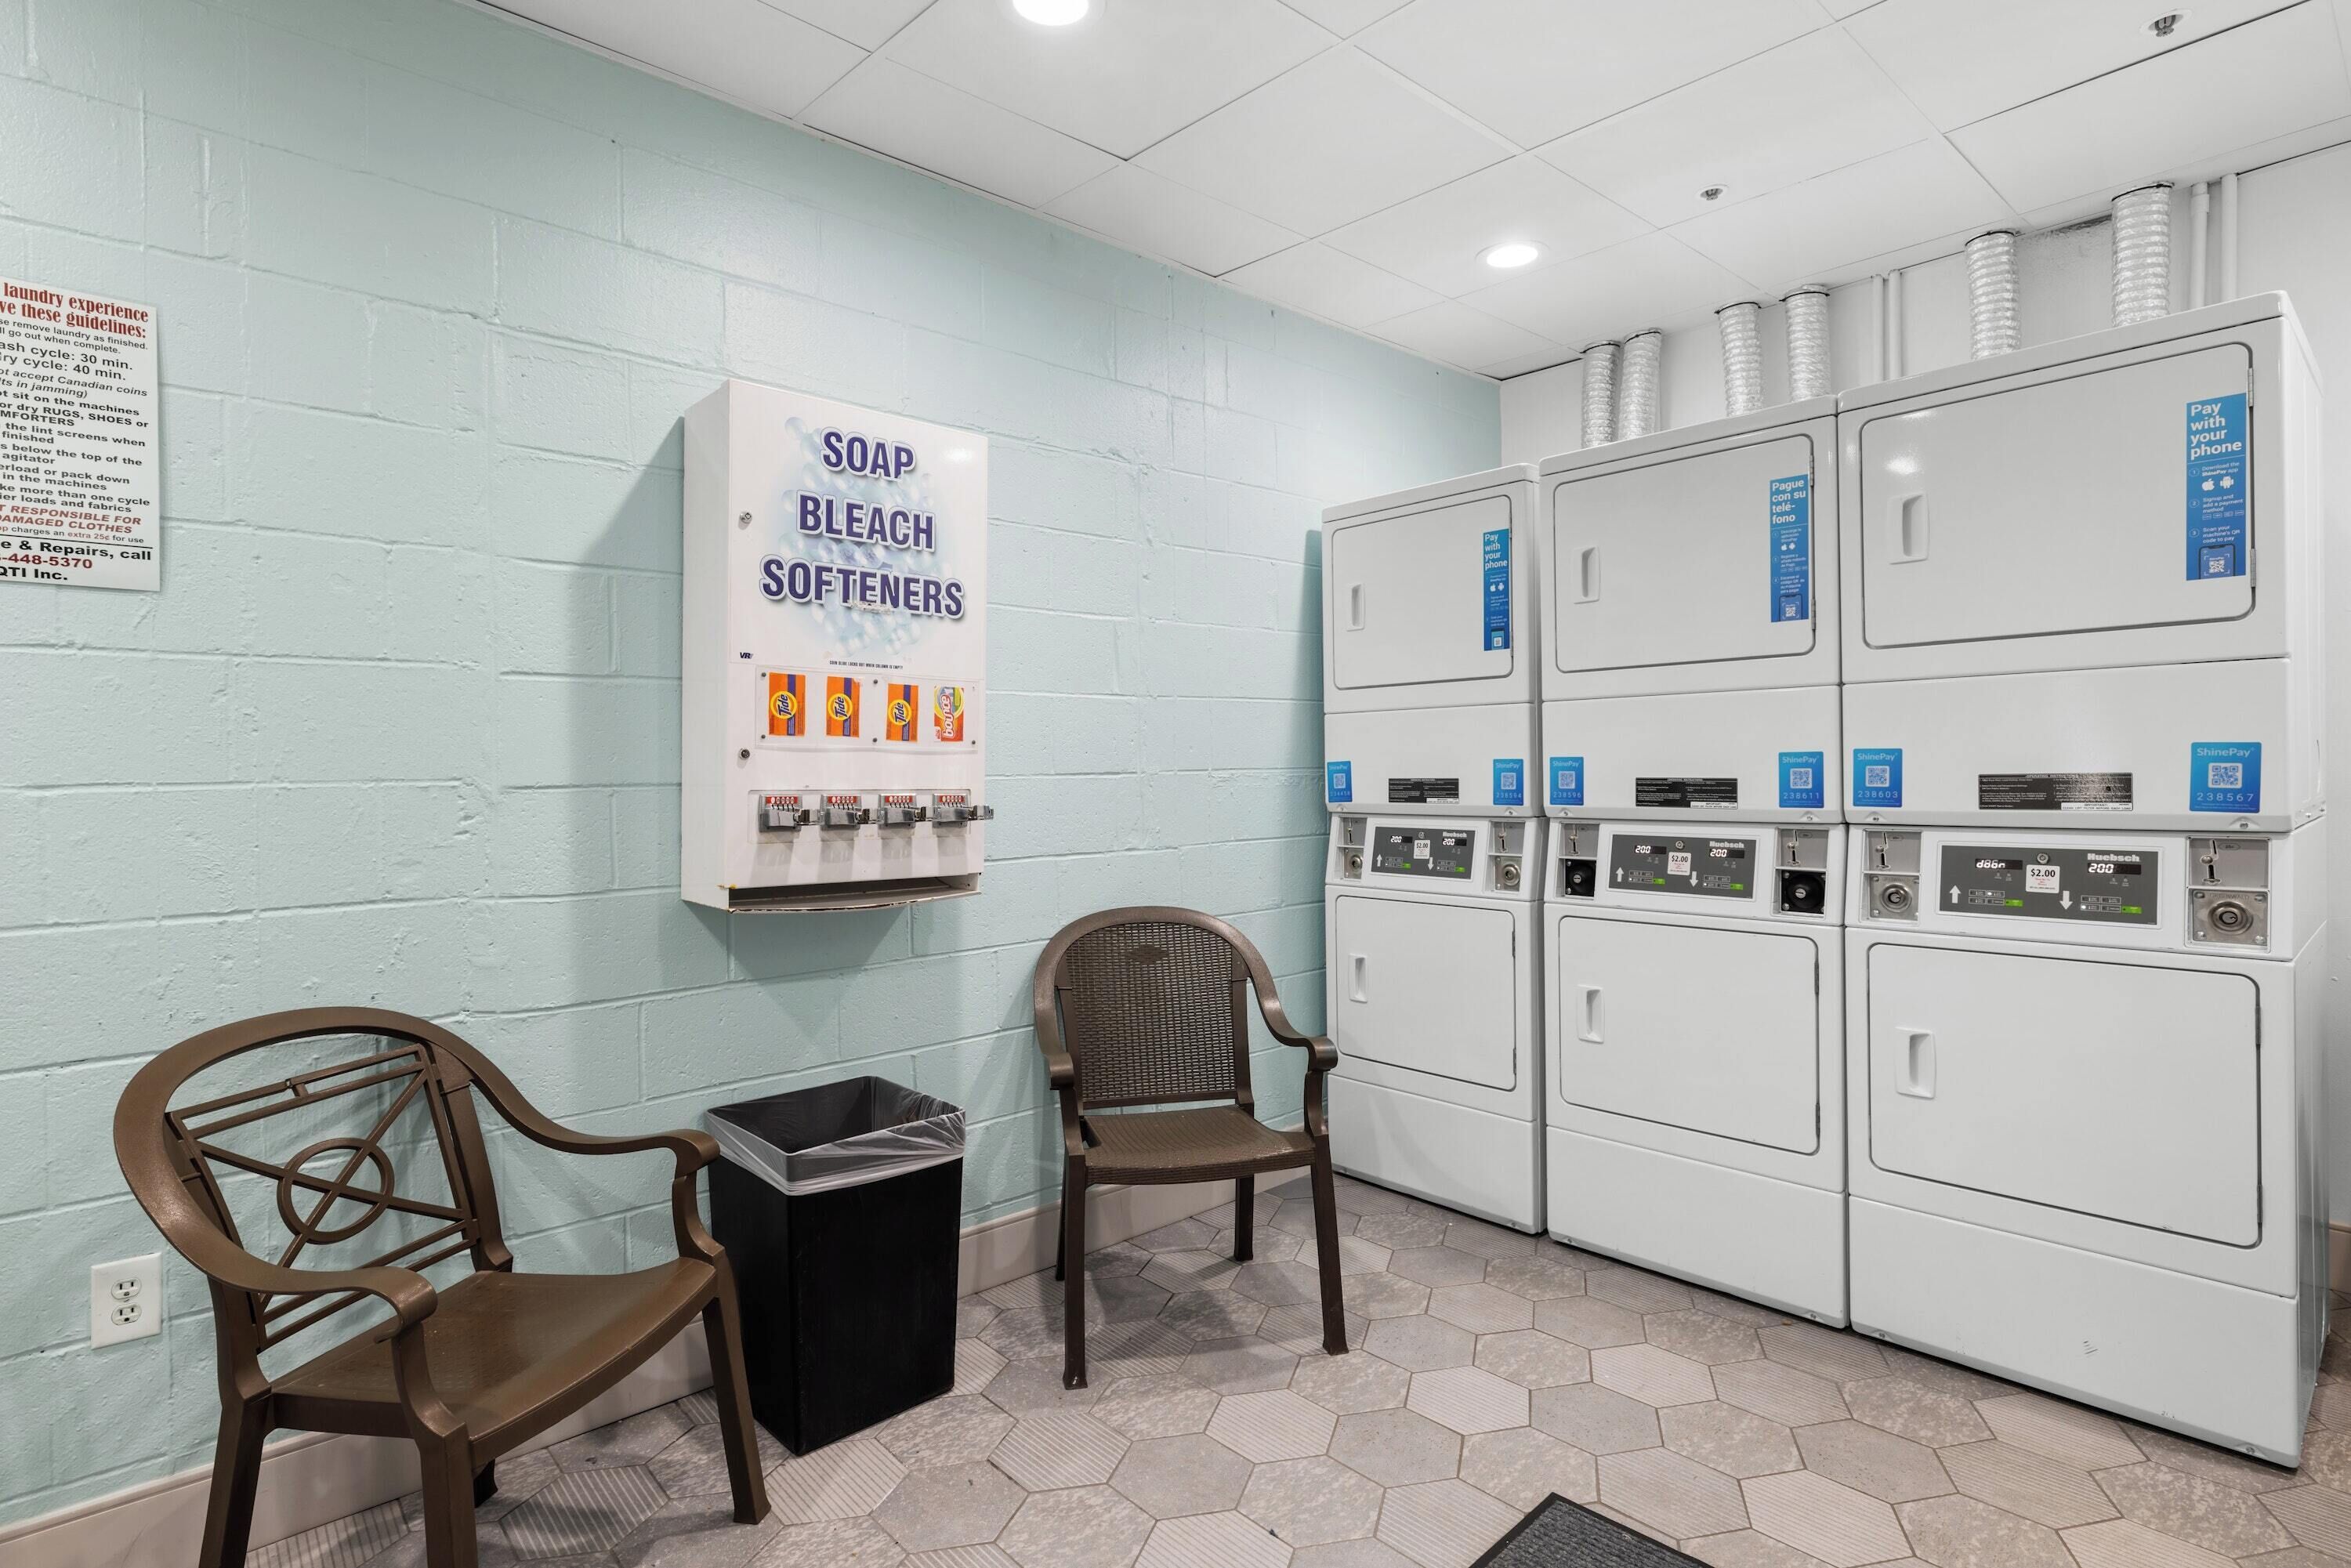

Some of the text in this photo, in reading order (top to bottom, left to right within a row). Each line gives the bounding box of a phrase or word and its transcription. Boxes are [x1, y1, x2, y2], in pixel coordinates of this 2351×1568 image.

[4, 282, 148, 323] laundry experience
[21, 303, 61, 323] these
[66, 312, 146, 339] guidelines:
[13, 321, 50, 332] remove
[54, 327, 90, 341] laundry
[108, 337, 147, 349] finished.
[44, 335, 70, 345] when
[74, 341, 121, 354] complete.
[0, 342, 132, 370] ash cycle: 30 min.
[24, 358, 67, 371] cycle:
[73, 364, 89, 375] 40
[96, 369, 125, 380] min.
[13, 371, 54, 382] accept
[58, 376, 112, 391] Canadian
[117, 387, 147, 397] coins
[16, 380, 27, 389] in
[30, 382, 87, 398] jamming)
[13, 392, 29, 400] sit
[54, 397, 74, 406] the
[79, 402, 139, 416] machines
[2191, 402, 2222, 417] Pay
[0, 410, 74, 426] MFORTERS
[17, 404, 38, 414] dry
[43, 407, 84, 420] RUGS,
[89, 413, 132, 425] SHOES
[2191, 416, 2226, 431] with
[2, 431, 54, 444] finished
[5, 422, 145, 447] the lint screens when
[2190, 429, 2227, 447] your
[2, 453, 55, 464] agitator
[13, 444, 52, 454] below
[56, 449, 77, 458] the
[82, 452, 101, 462] top
[822, 430, 915, 480] SOAP
[2191, 441, 2242, 461] phone
[0, 464, 39, 473] erload
[96, 474, 130, 483] down
[45, 478, 107, 490] machines
[1772, 480, 1804, 492] Pague
[0, 483, 15, 491] ke
[20, 487, 53, 495] more
[58, 490, 86, 499] than
[118, 498, 150, 506] cycle
[1772, 490, 1806, 502] con su
[21, 495, 56, 505] loads
[89, 502, 132, 512] fabrics
[1772, 502, 1795, 512] telé-
[11, 505, 110, 522] RESPONSIBLE
[114, 516, 141, 525] FOR
[799, 494, 933, 550] BLEACH
[1772, 514, 1795, 524] fono
[12, 527, 50, 535] charges
[68, 521, 132, 534] CLOTHES
[1484, 534, 1498, 542] Pay
[19, 541, 32, 550] &
[40, 542, 114, 559] Repairs,
[120, 551, 151, 560] call
[1485, 551, 1502, 559] your
[0, 553, 92, 569] -448-5370
[1485, 559, 1508, 570] phone
[34, 569, 68, 580] Inc.
[762, 558, 963, 617] SOFTENERS
[777, 694, 792, 715] Tide
[835, 697, 848, 717] Tide
[894, 702, 907, 722] Tide
[941, 694, 955, 737] bounce
[1782, 756, 1818, 765] ShinePay
[2197, 748, 2251, 758] ShinePay
[2197, 792, 2254, 802] 238567
[1710, 849, 1727, 857] 200
[2087, 853, 2140, 862] Huebsch
[2030, 868, 2056, 878] $2.00
[2088, 863, 2114, 873] 200
